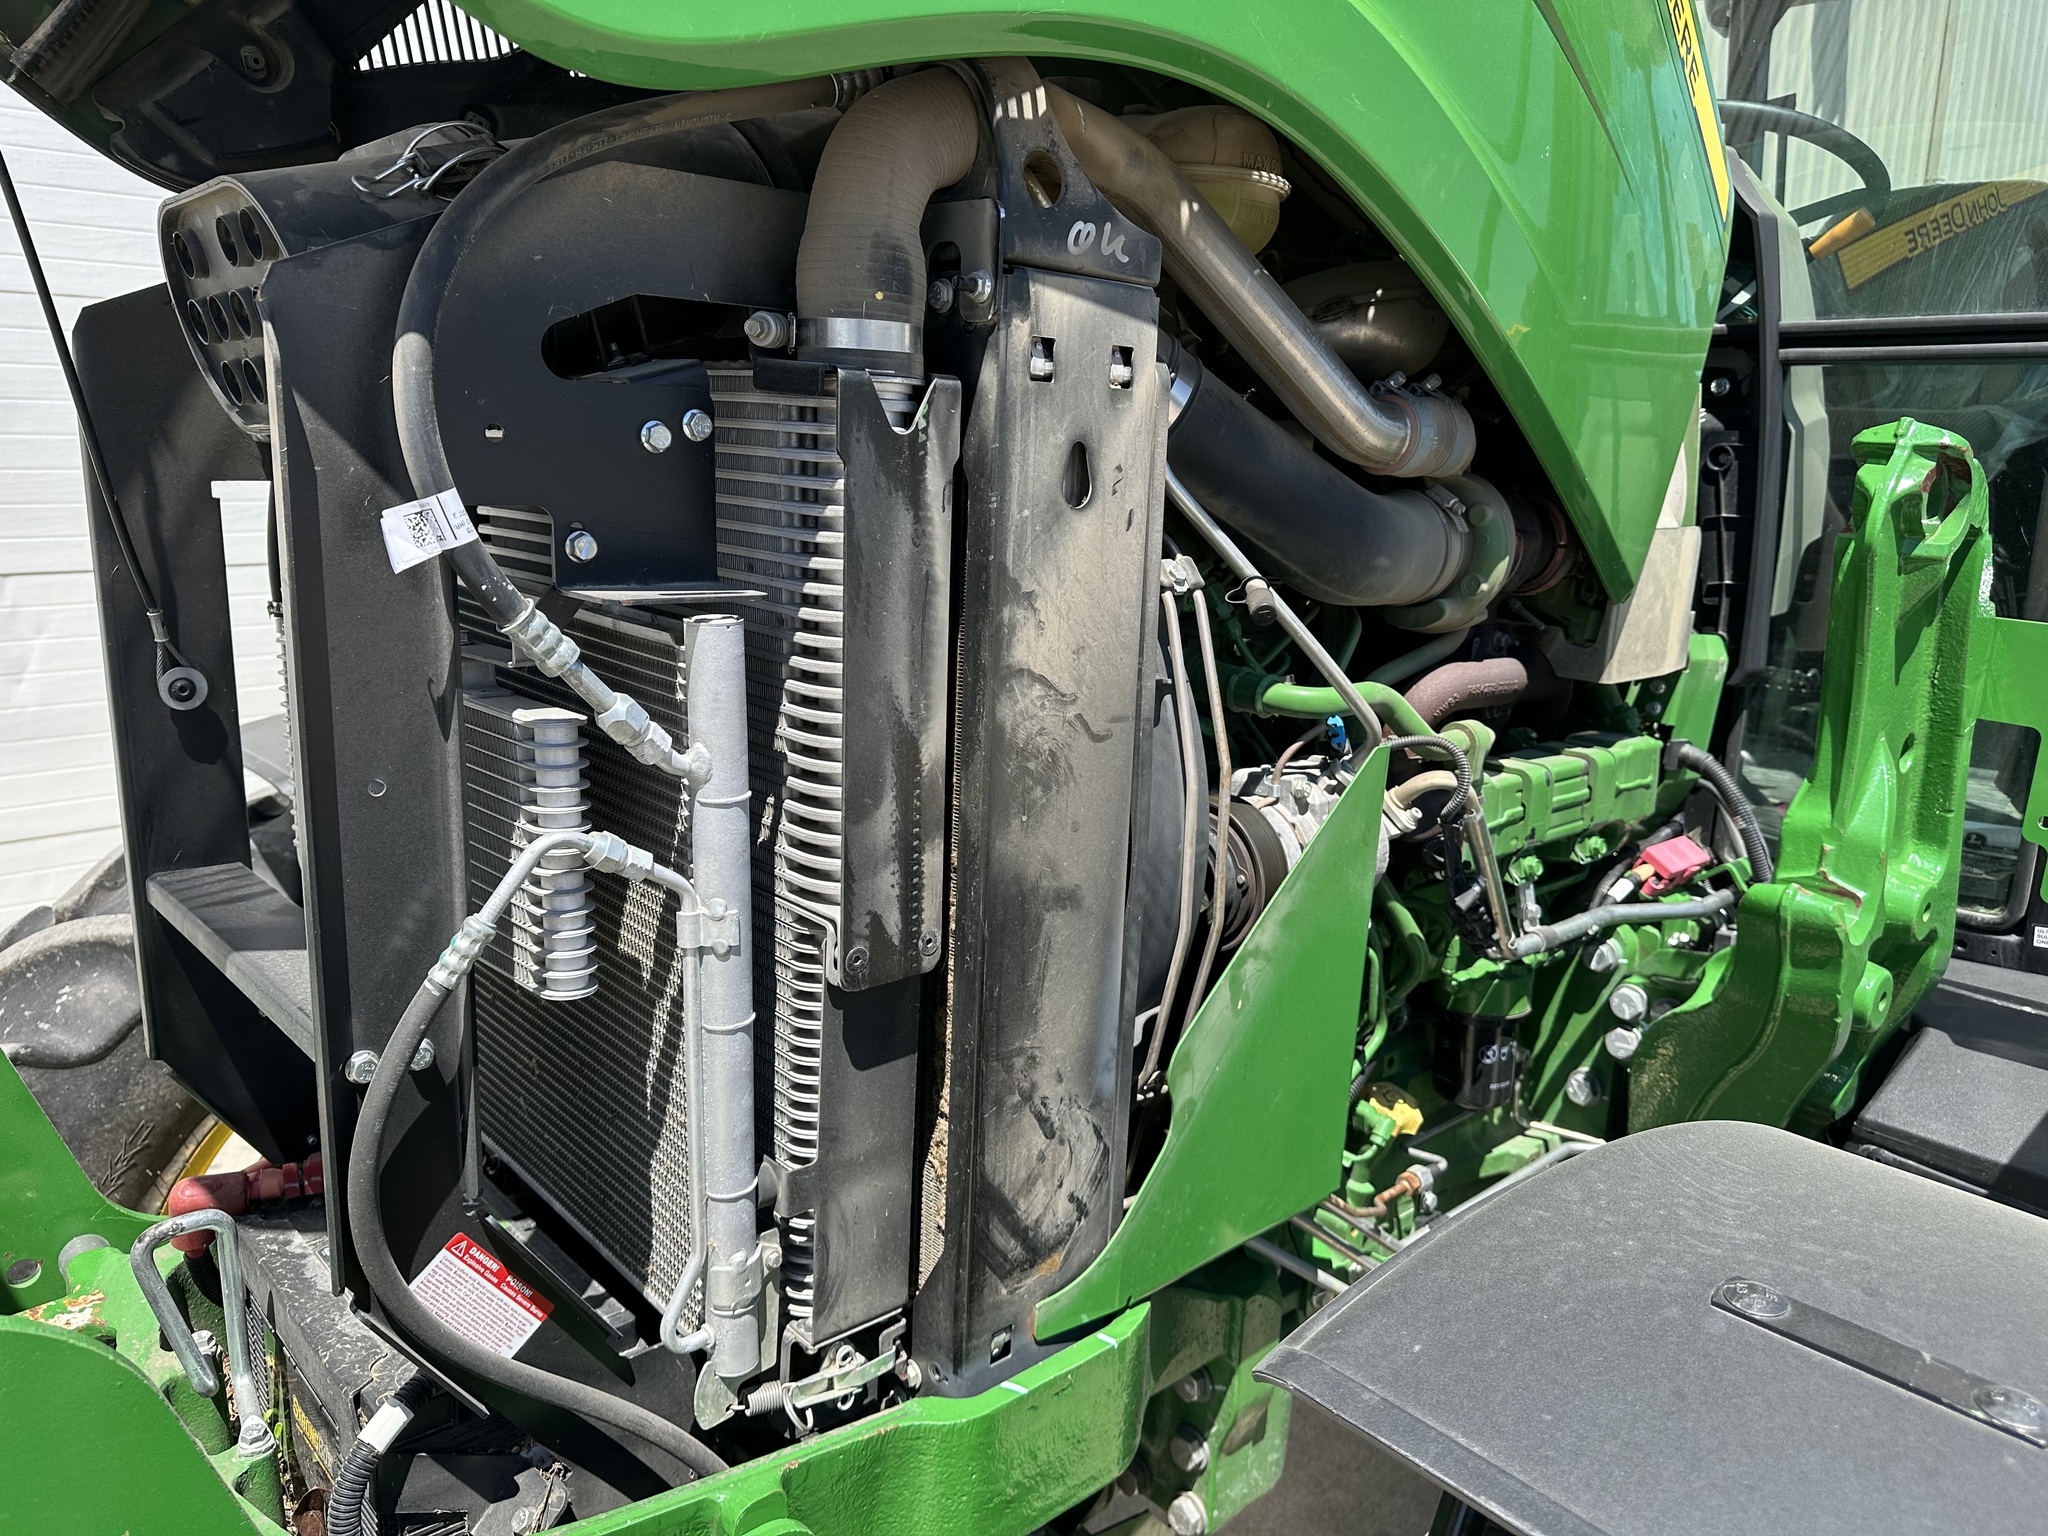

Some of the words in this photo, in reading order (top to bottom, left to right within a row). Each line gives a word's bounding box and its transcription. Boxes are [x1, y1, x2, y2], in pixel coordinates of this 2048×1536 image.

[1669, 0, 1699, 98] ERE
[462, 1253, 485, 1274] Explosive
[483, 1269, 499, 1283] Gases
[468, 1246, 499, 1272] DANGER!
[499, 1282, 517, 1298] Causes
[515, 1294, 531, 1308] Severe
[529, 1305, 543, 1318] Burns
[505, 1274, 533, 1298] POISON!
